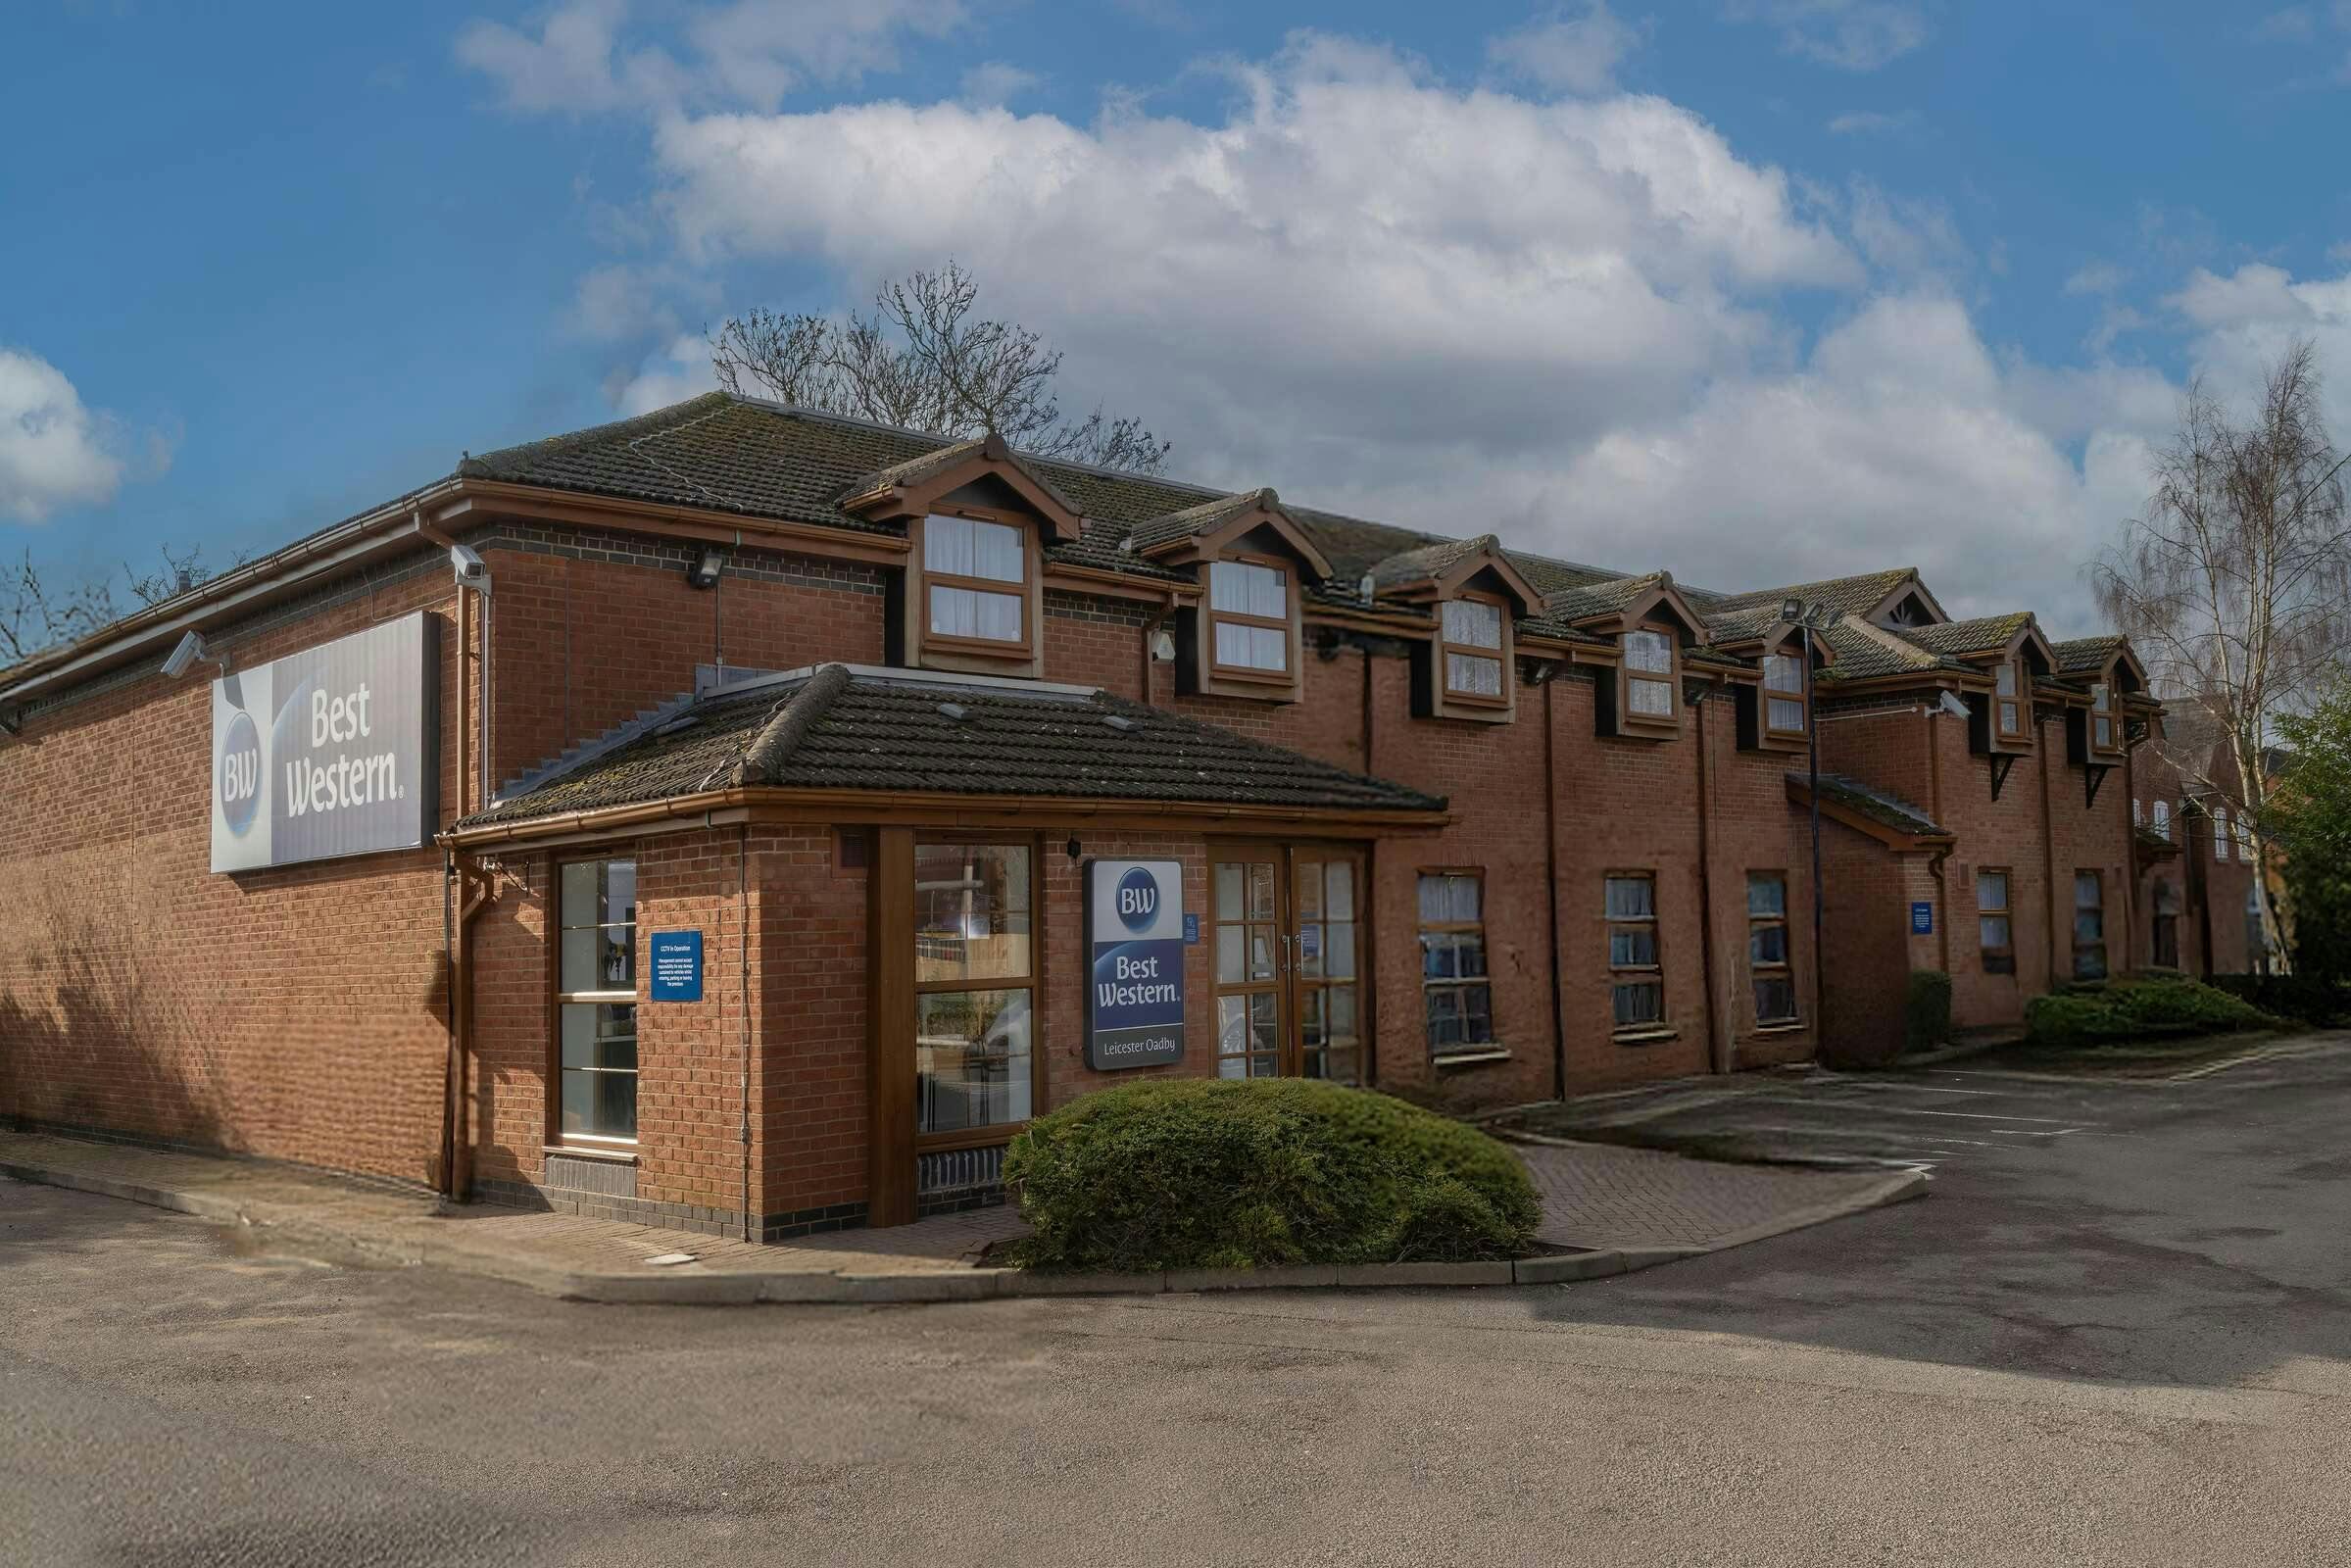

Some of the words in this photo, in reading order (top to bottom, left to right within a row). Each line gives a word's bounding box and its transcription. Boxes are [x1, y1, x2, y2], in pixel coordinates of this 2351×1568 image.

[312, 683, 370, 748] Best
[224, 748, 257, 802] BW
[1121, 888, 1155, 914] BW
[1116, 956, 1158, 980] Best
[1104, 1039, 1144, 1055] Leicester
[1146, 1037, 1176, 1053] Oadby
